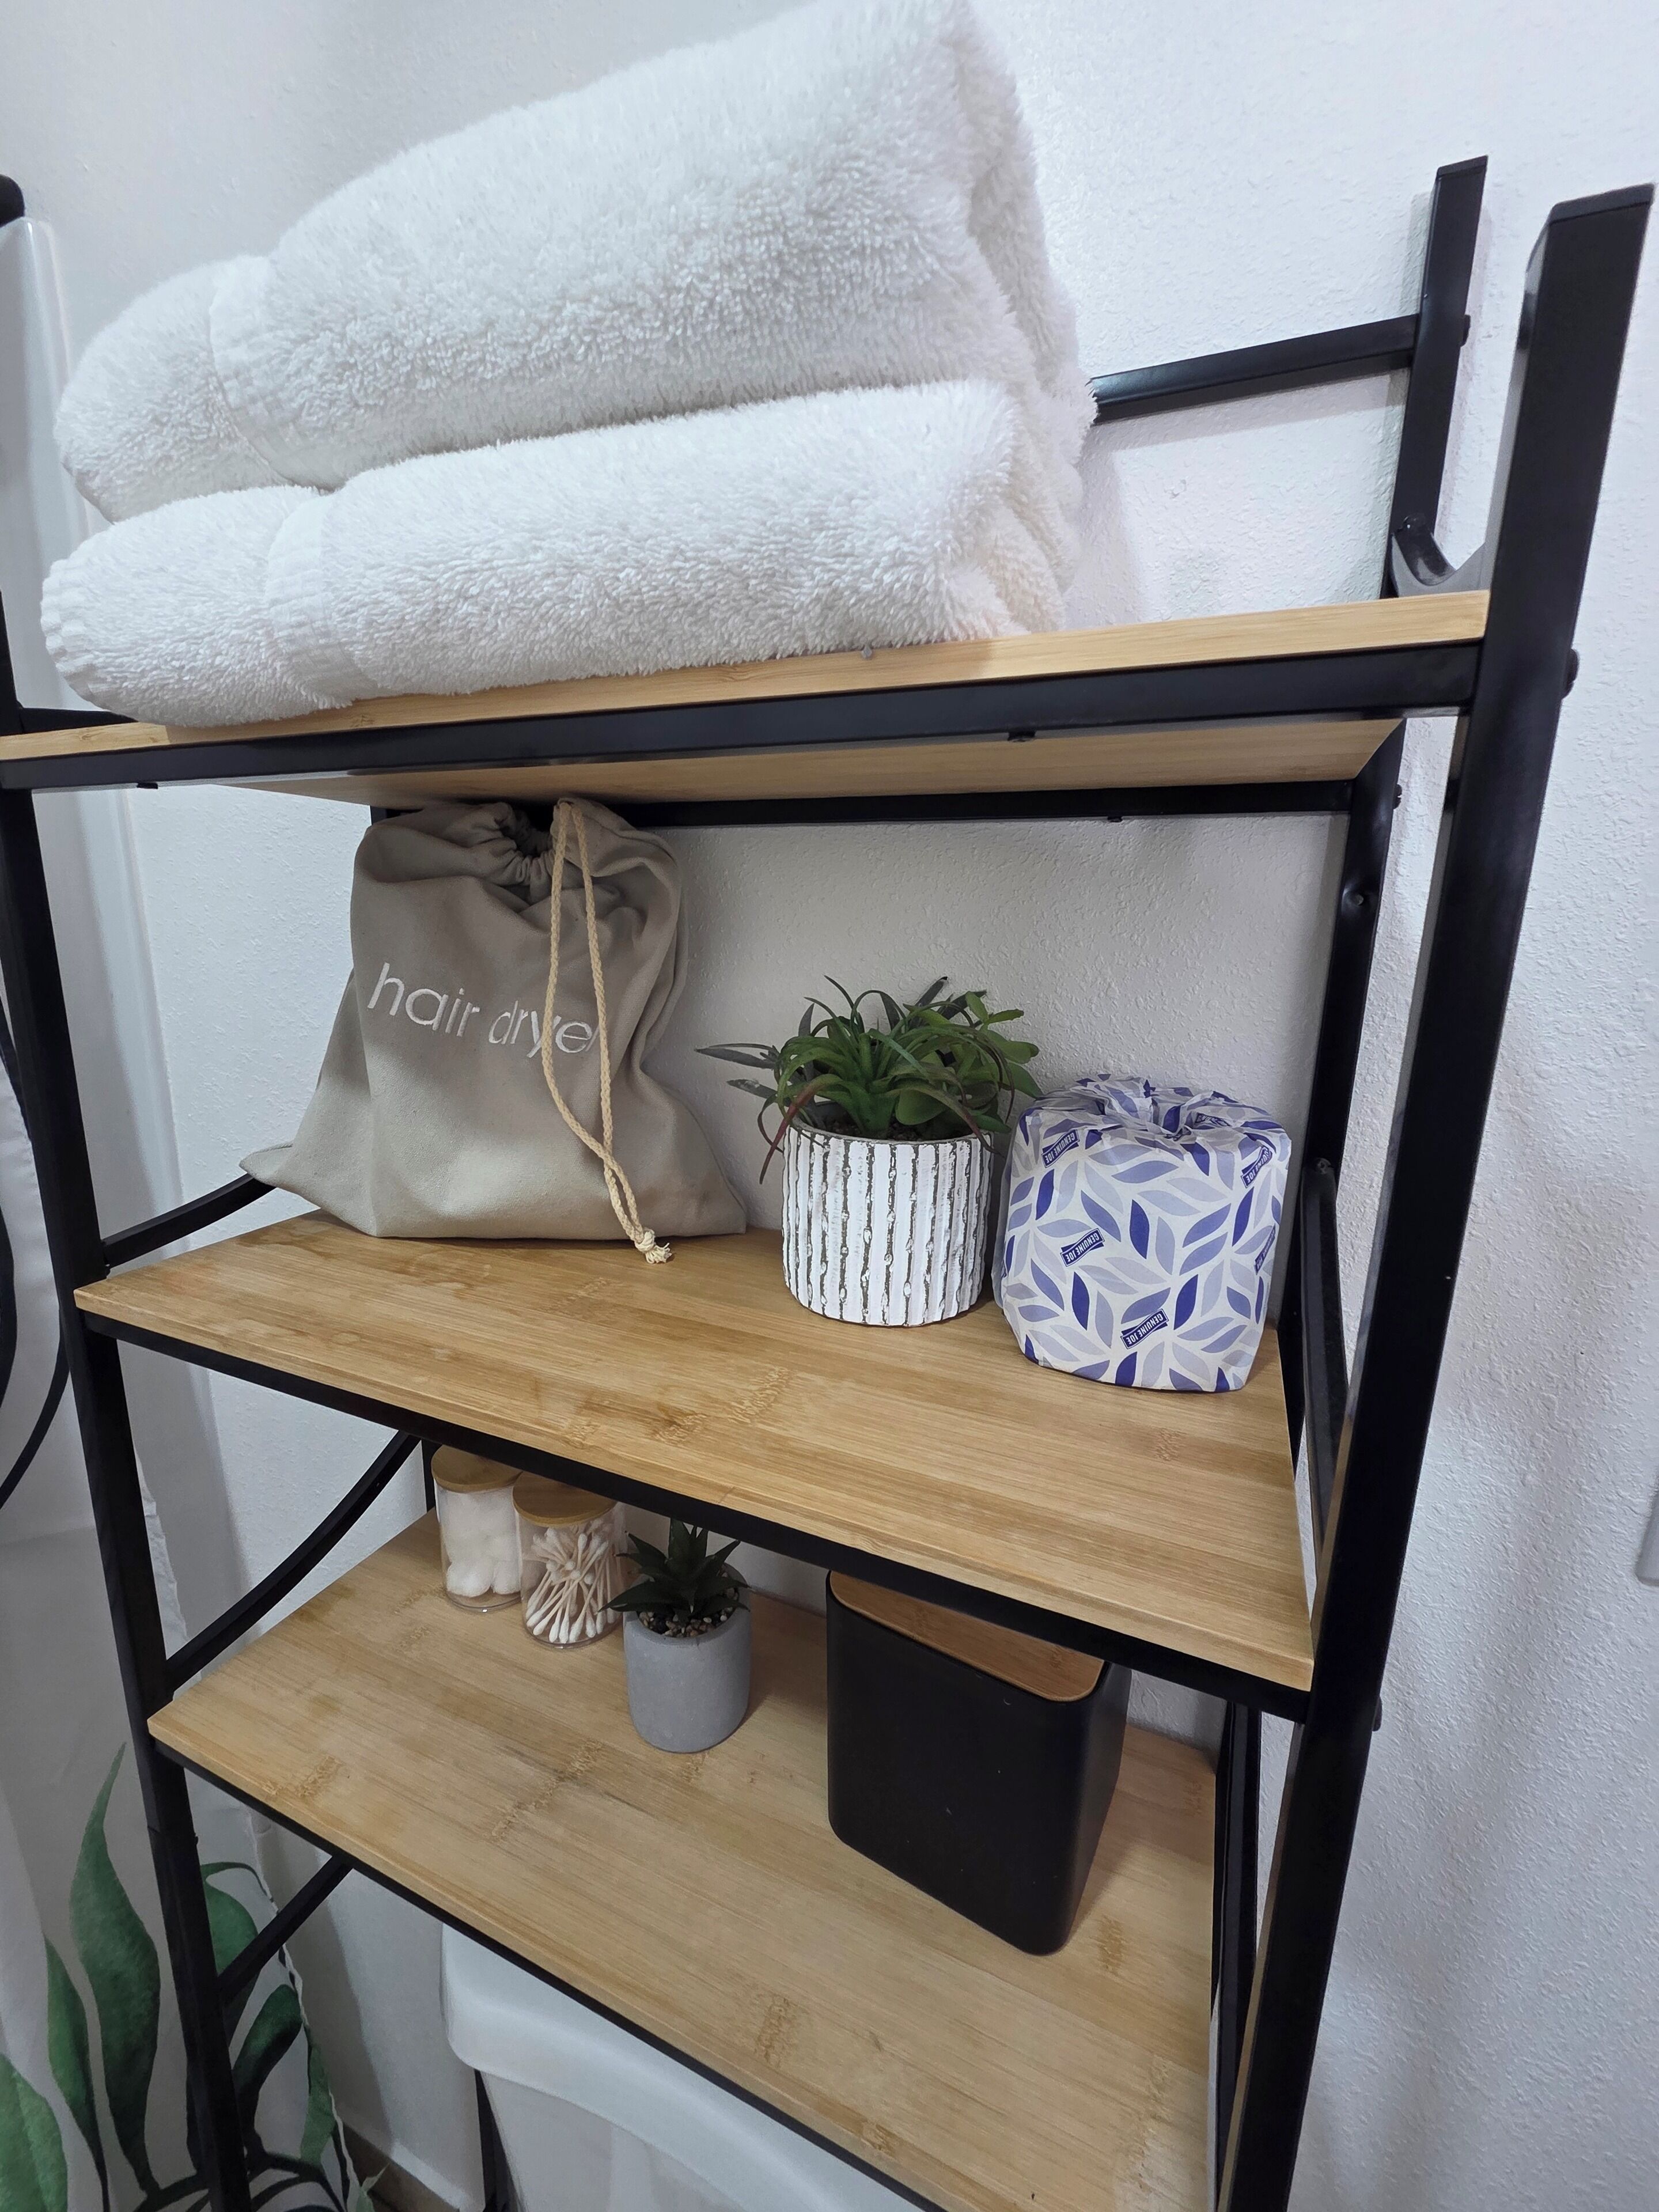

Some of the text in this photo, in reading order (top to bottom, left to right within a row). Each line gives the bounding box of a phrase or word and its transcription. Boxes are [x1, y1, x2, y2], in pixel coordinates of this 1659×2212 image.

[368, 962, 480, 1036] hair
[1044, 1132, 1075, 1164] GENUINE JOE
[1245, 1169, 1256, 1183] JOE
[1065, 1233, 1100, 1262] GENUINE JOE
[1126, 1313, 1164, 1344] GENUINE JOE
